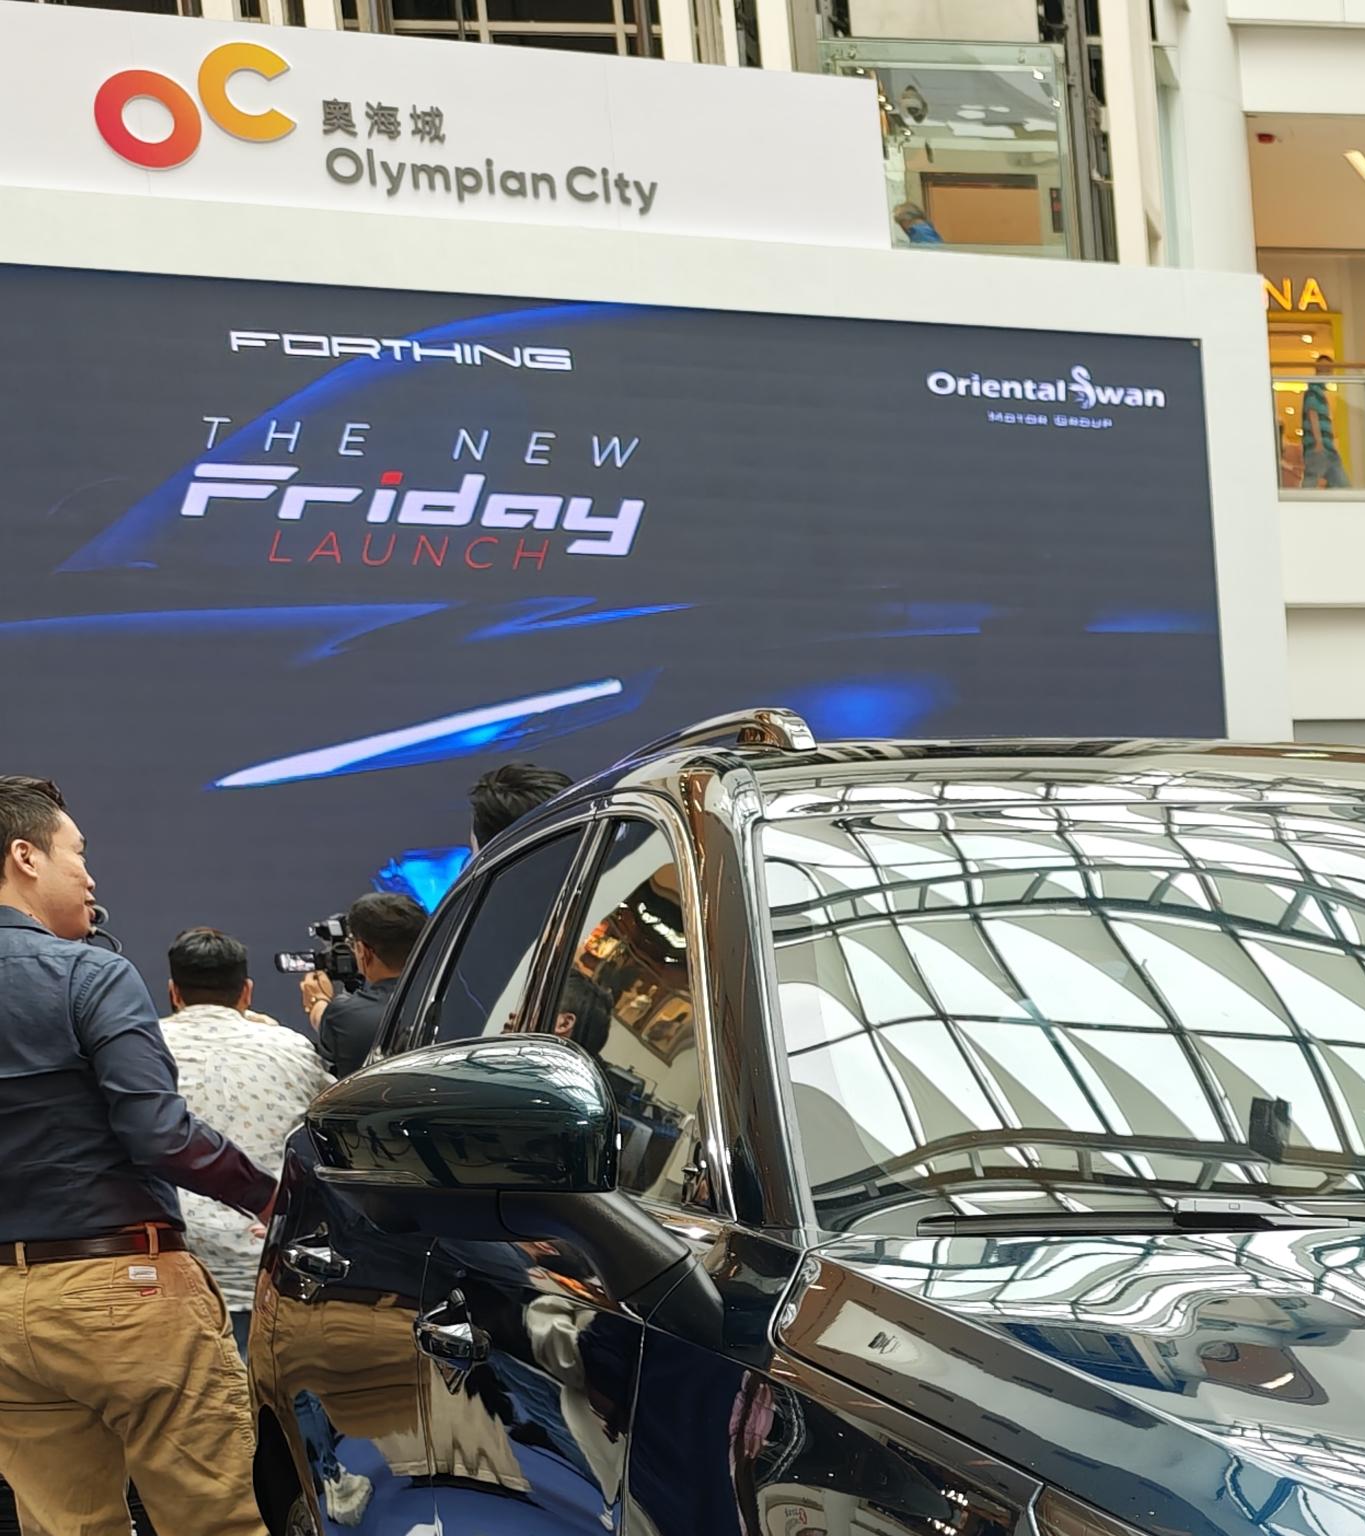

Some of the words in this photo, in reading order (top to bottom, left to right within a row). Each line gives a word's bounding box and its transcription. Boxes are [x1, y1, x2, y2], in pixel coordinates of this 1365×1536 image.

[325, 148, 556, 202] Olympian
[566, 166, 659, 215] City
[229, 331, 573, 372] FORTHING
[926, 371, 1067, 402] Oriental
[201, 415, 371, 458] THE
[452, 428, 641, 470] NEW
[180, 463, 645, 557] Friday
[268, 530, 552, 571] LAUNCH
